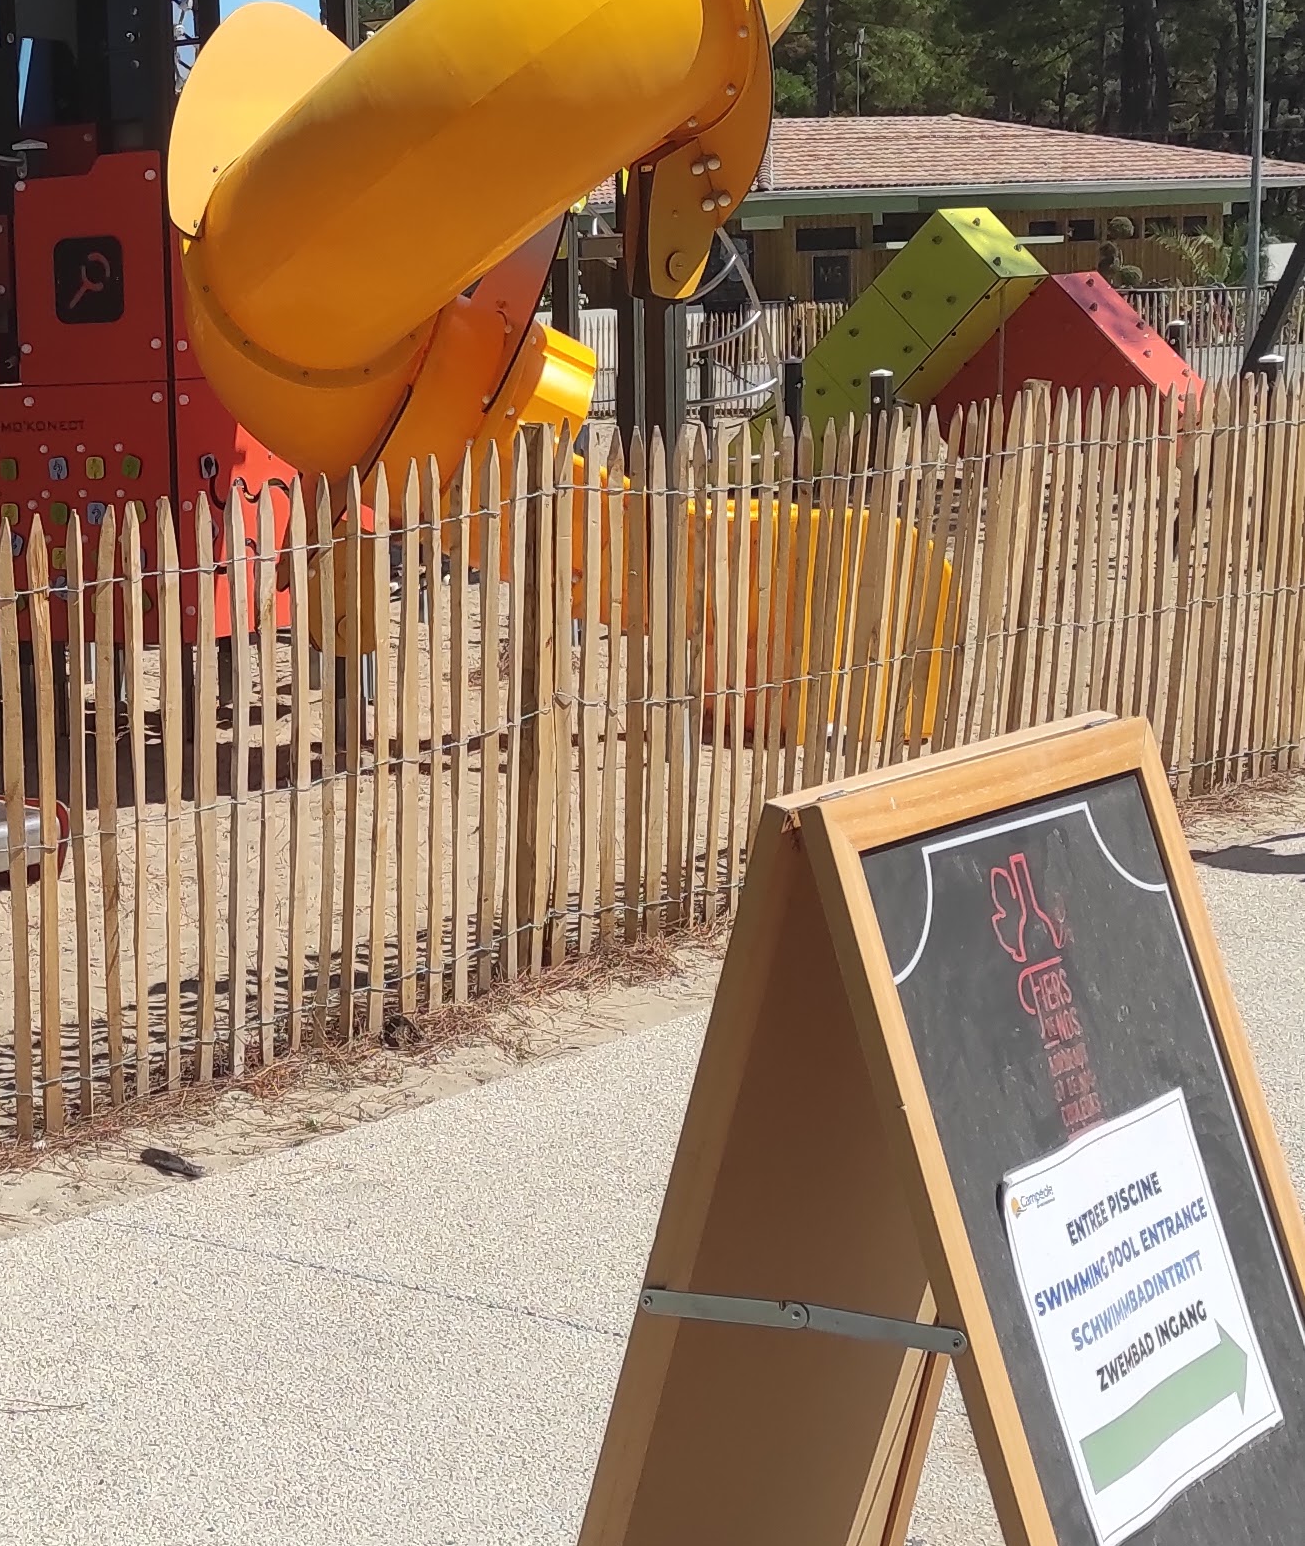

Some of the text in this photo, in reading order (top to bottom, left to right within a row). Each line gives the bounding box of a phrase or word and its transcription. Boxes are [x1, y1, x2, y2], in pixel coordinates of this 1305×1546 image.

[1034, 1197, 1208, 1316] SWIMMING POOL ENTRANCE
[1066, 1171, 1162, 1246] ENTREE PISCINE
[1071, 1249, 1203, 1352] SCHWIMMBADINTRITT
[1096, 1299, 1207, 1392] ZWEMBAD INGANG
